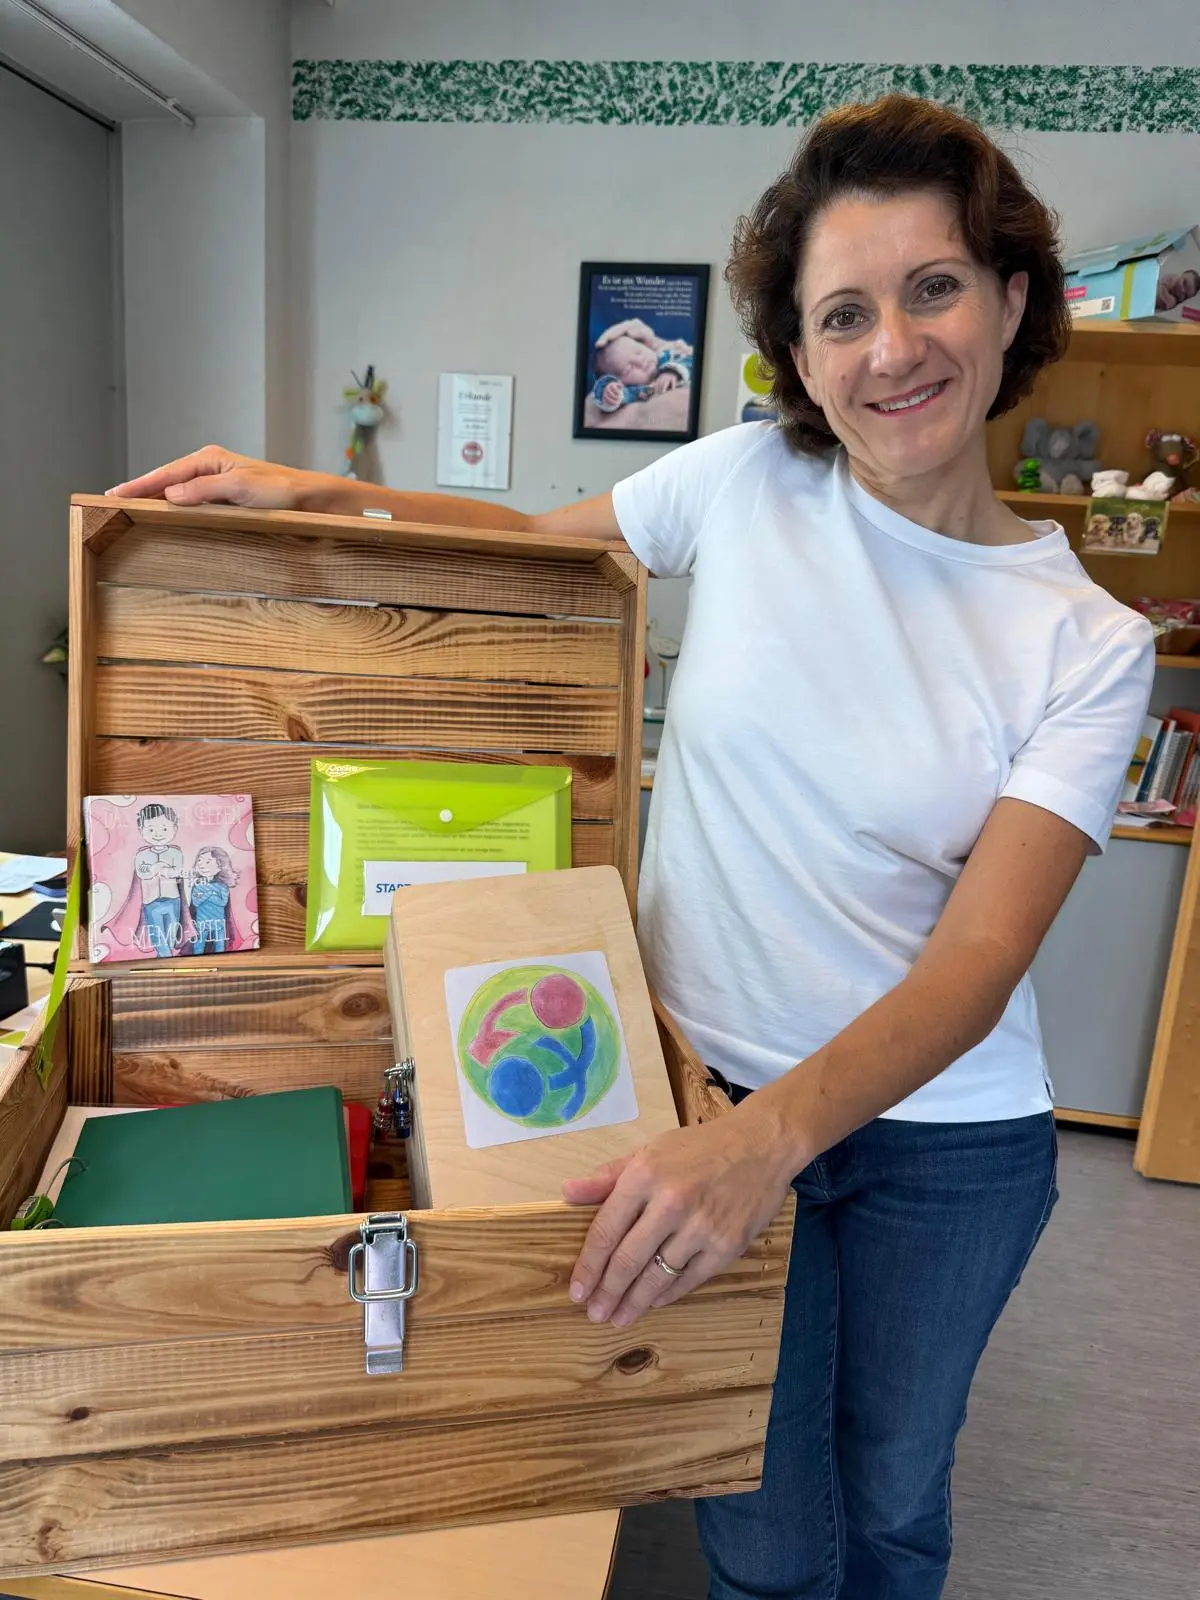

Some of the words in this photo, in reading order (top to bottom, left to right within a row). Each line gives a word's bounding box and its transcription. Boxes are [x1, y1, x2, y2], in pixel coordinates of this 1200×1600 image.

[602, 275, 611, 285] Es
[612, 275, 621, 286] ist
[634, 275, 666, 286] Wunder
[128, 918, 230, 949] MEMO-SPIEL
